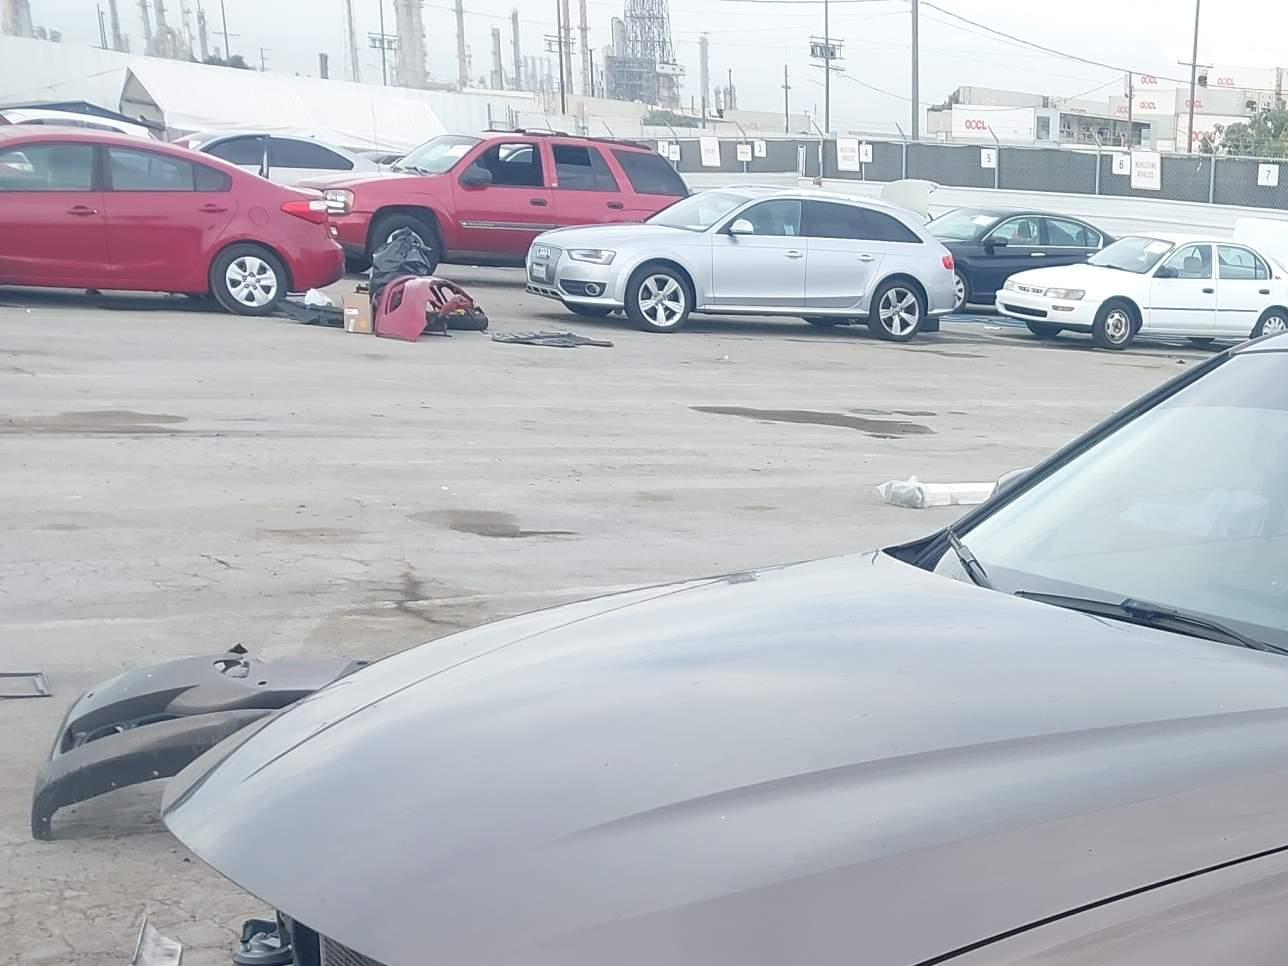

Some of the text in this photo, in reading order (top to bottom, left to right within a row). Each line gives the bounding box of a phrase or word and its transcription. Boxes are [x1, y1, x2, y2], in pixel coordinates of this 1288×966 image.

[1217, 77, 1236, 86] OOCL
[1139, 101, 1157, 110] OOCL
[1184, 99, 1204, 109] OCL
[965, 119, 987, 130] OOCL
[985, 153, 992, 163] 5
[1118, 159, 1125, 170] 6
[1265, 169, 1272, 181] 7
